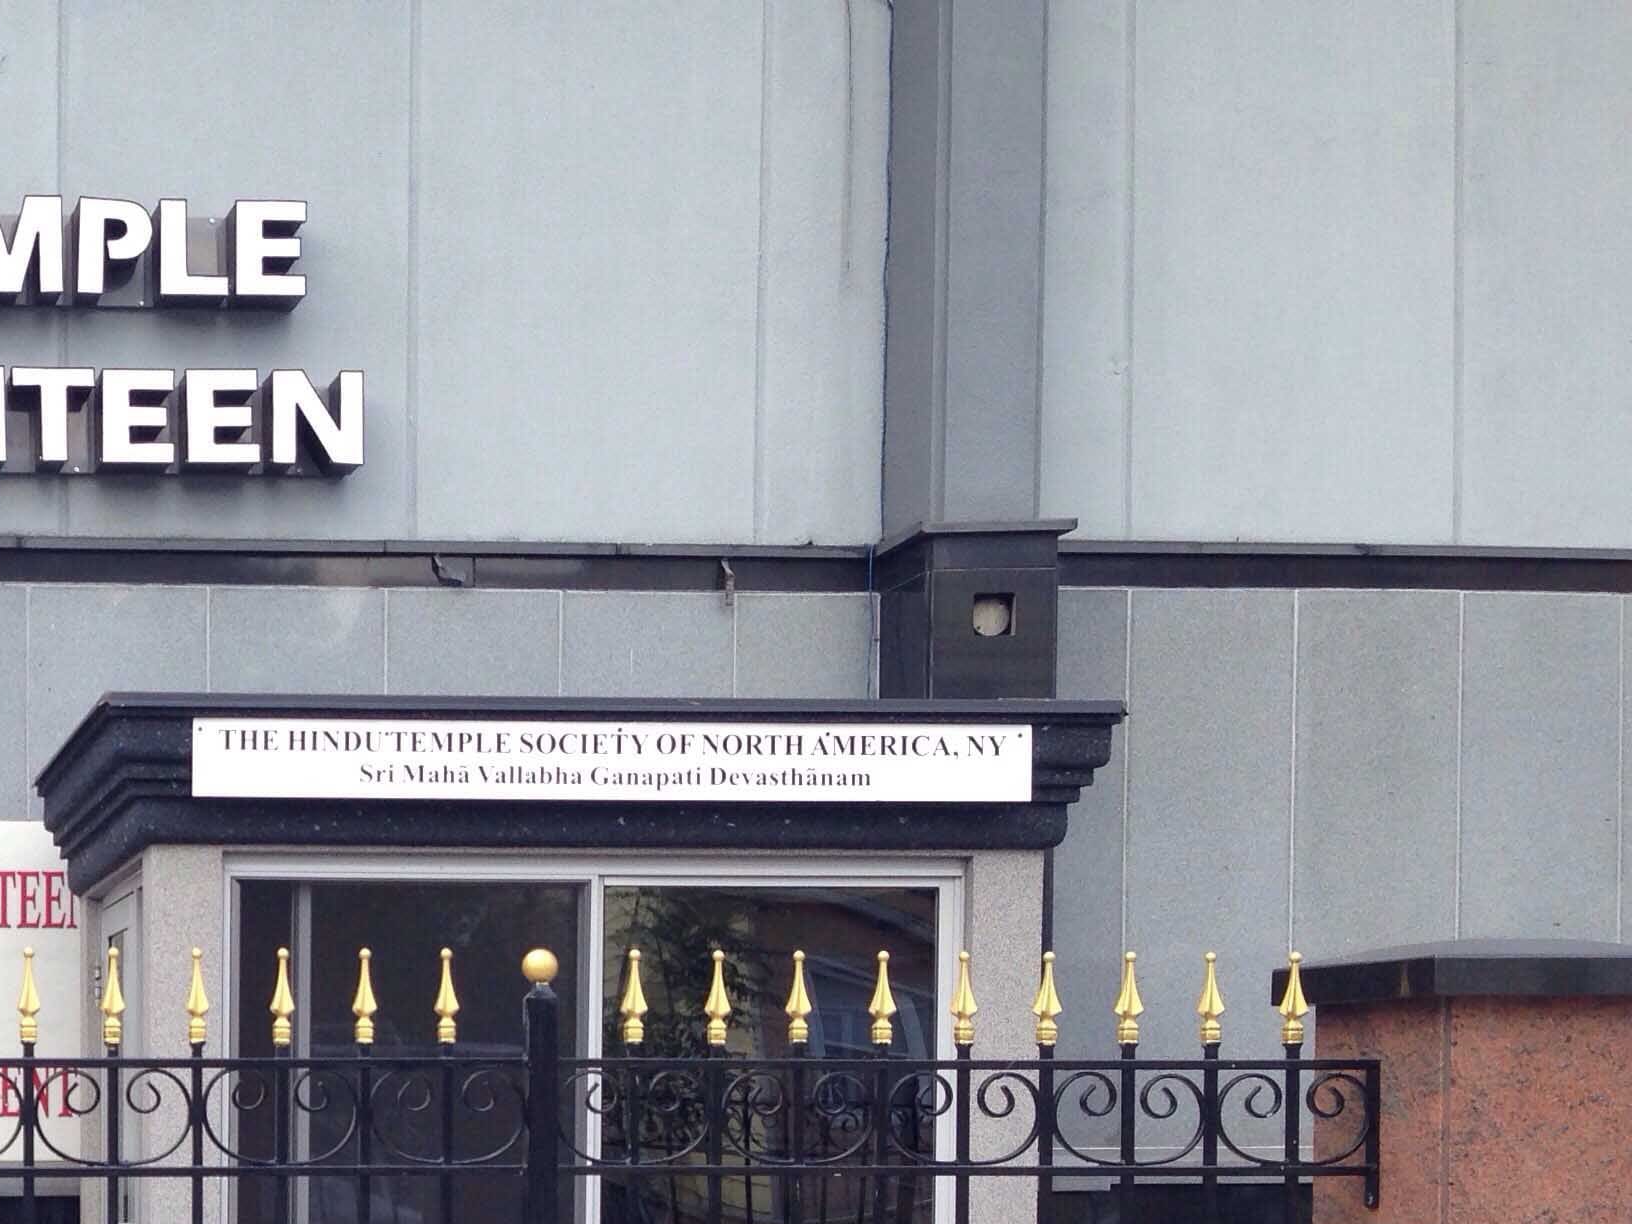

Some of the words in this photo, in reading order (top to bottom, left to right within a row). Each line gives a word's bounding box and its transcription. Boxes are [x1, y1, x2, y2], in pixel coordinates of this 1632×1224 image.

[219, 729, 279, 751] THE
[289, 730, 382, 752] HINDU
[388, 731, 512, 754] TEMPLE
[519, 732, 648, 755] SOCIETY
[656, 733, 696, 755] OF
[702, 734, 803, 756] NORTH
[811, 734, 959, 759] AMERICA,
[967, 735, 1007, 757] NY
[360, 764, 394, 784] Sri
[478, 766, 582, 786] Vallabha
[590, 767, 702, 791] Ganapati
